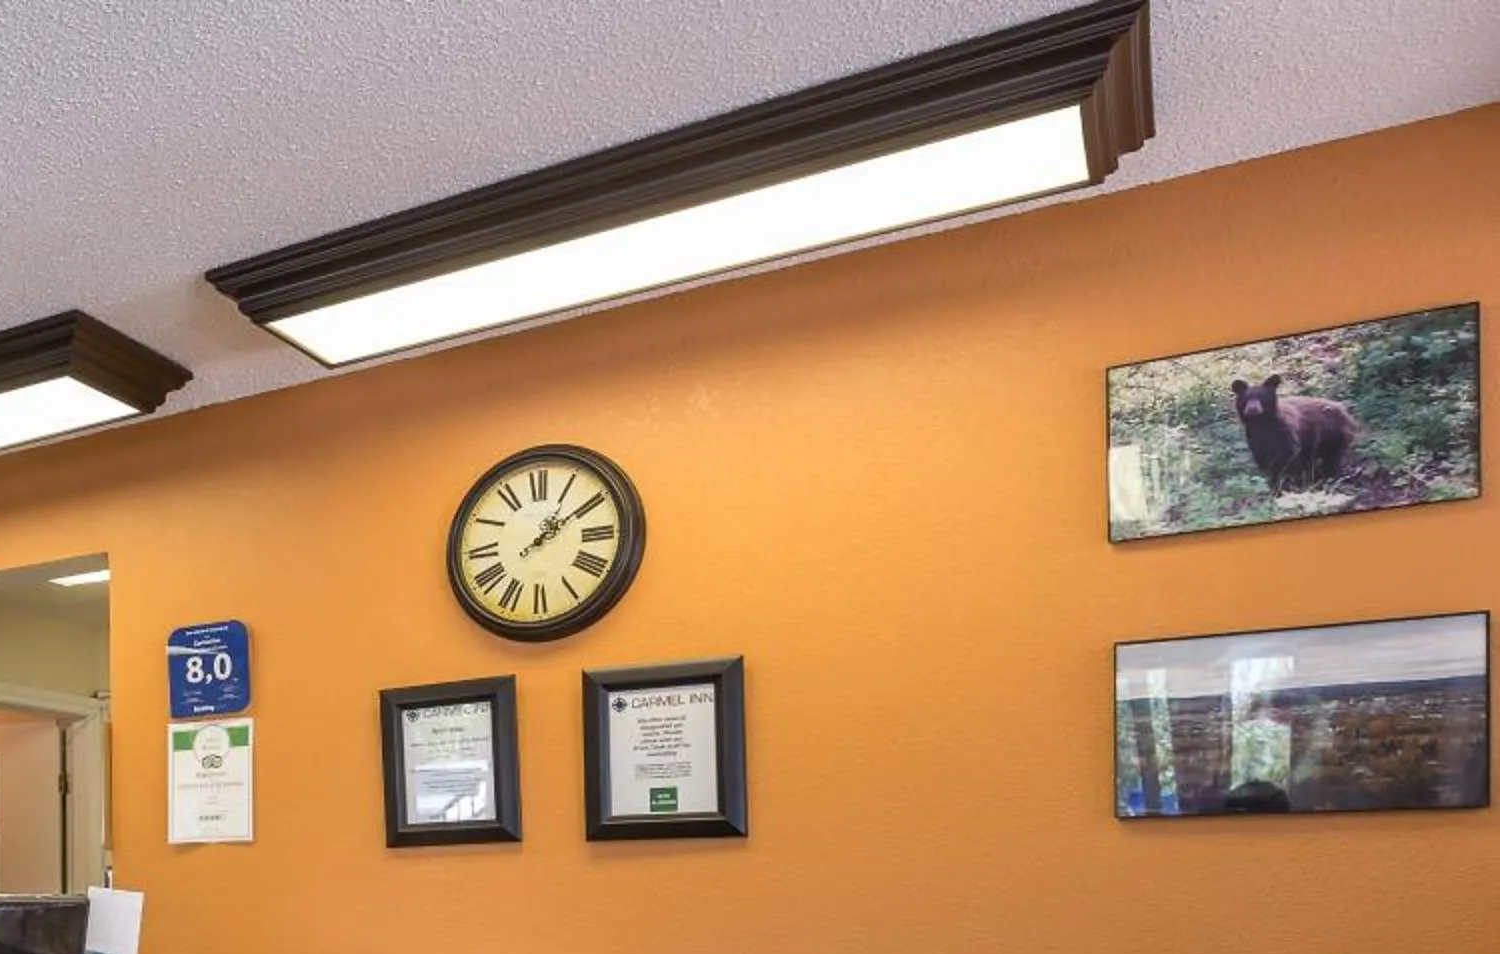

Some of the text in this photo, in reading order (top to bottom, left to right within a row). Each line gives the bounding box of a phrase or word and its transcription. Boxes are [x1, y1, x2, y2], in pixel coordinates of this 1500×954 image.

[186, 654, 232, 684] 8,0
[631, 691, 714, 709] CARMEL INN
